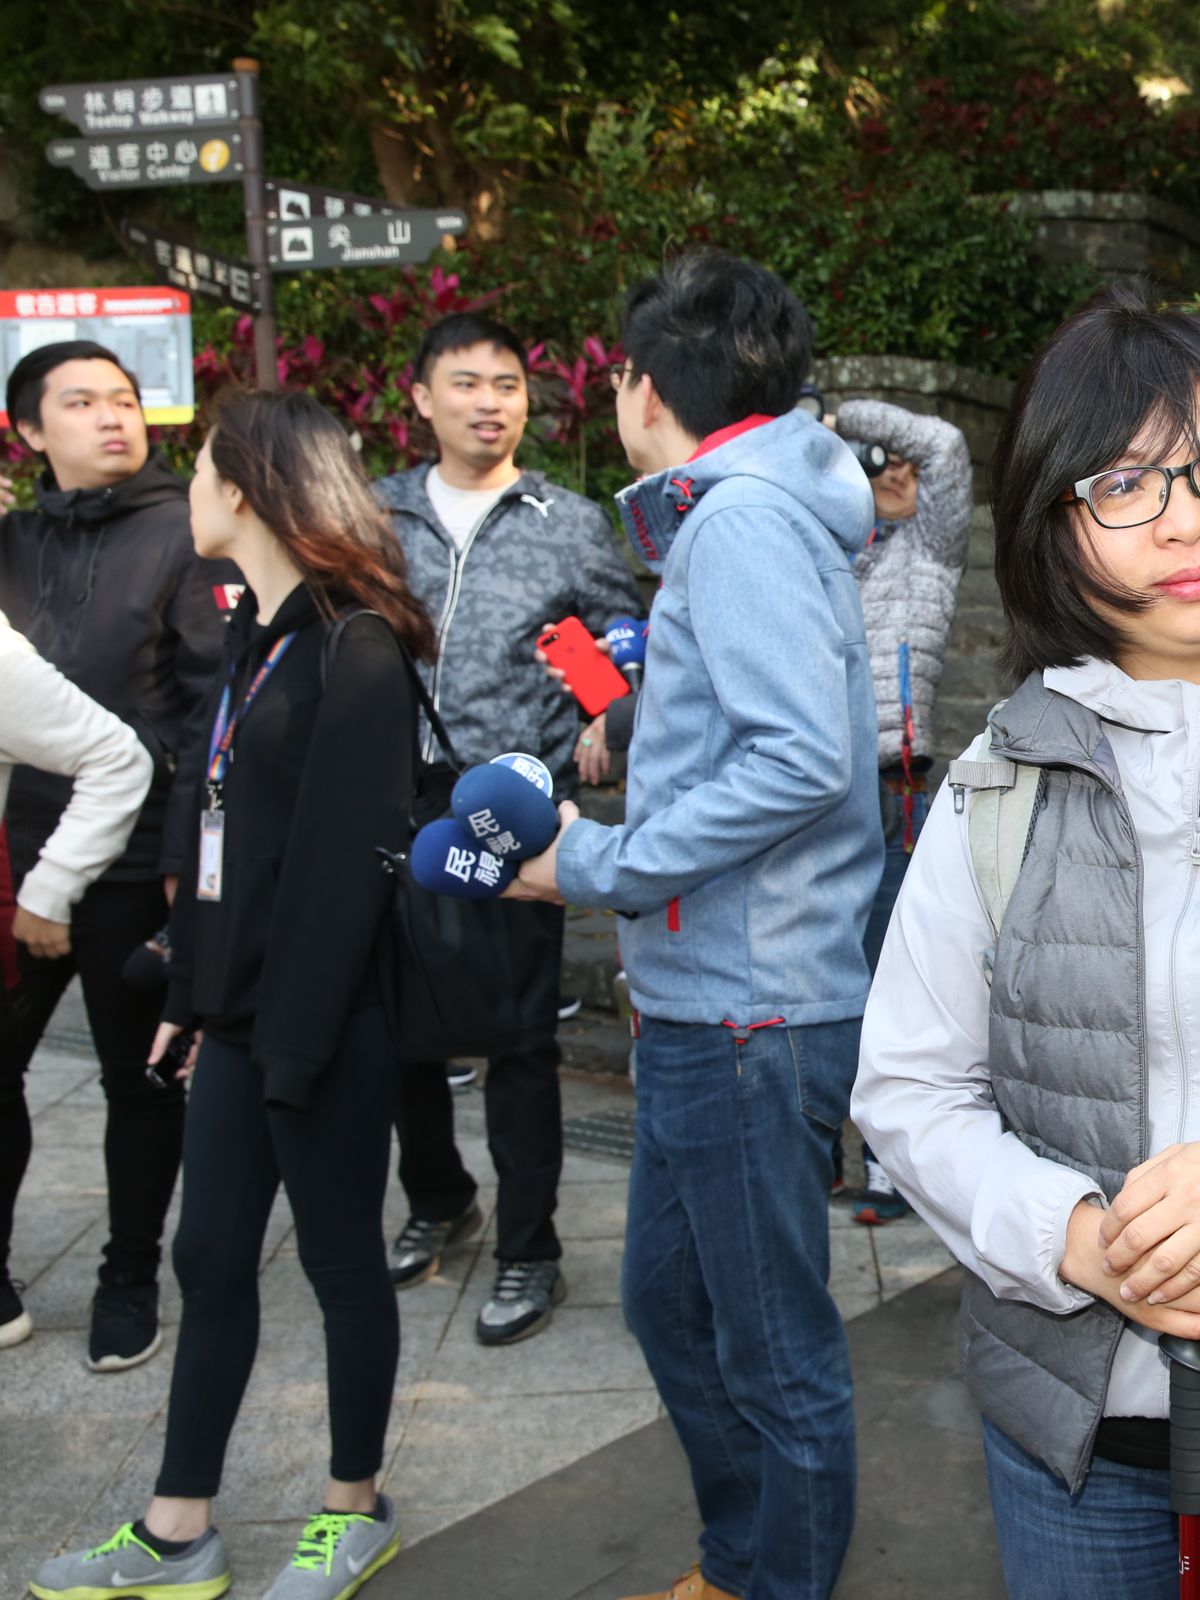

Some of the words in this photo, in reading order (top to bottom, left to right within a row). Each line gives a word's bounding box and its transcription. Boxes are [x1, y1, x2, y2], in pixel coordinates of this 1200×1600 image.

[89, 139, 198, 170] 遊客中心
[444, 846, 504, 888] 民視
